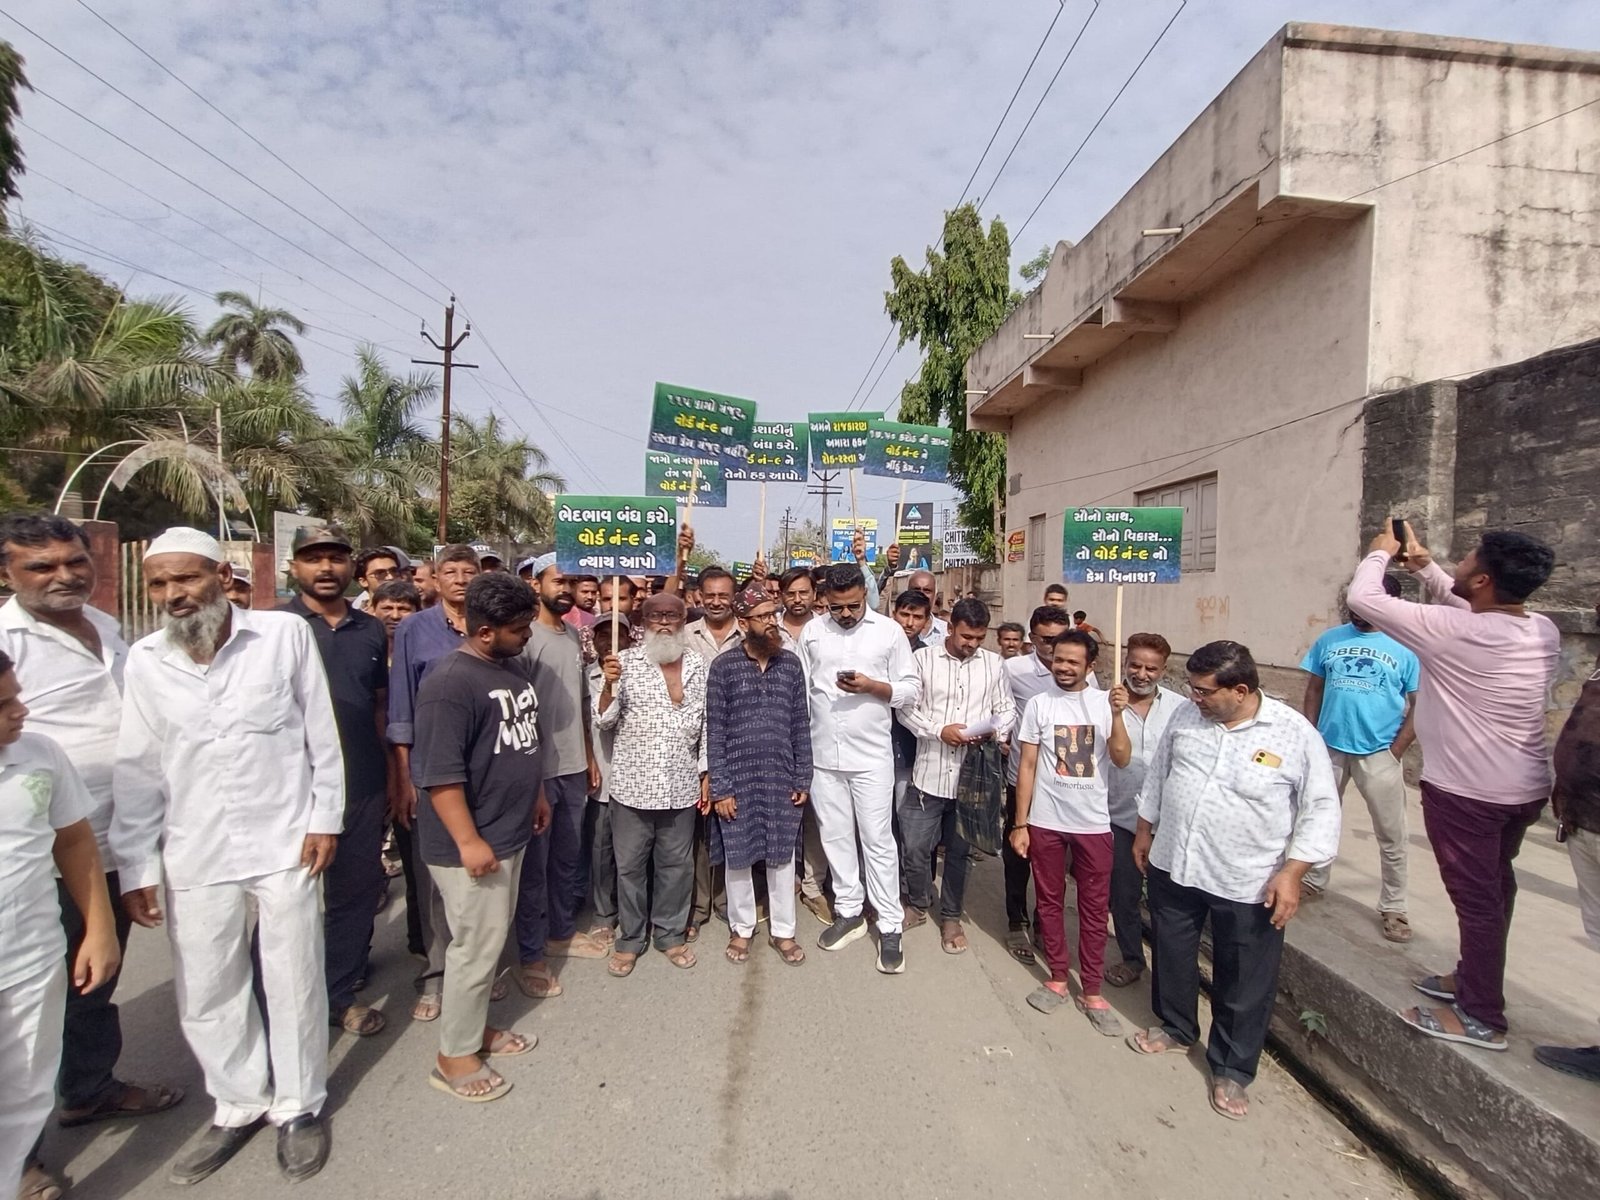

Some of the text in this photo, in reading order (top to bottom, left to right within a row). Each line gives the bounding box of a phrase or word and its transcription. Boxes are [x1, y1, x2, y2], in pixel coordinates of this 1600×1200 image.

[674, 412, 696, 429] વોર્ડ
[721, 426, 734, 436] ના
[810, 419, 867, 432] અમને રાજકારણ
[753, 439, 773, 449] બંધ
[825, 438, 850, 448] અમારા
[885, 444, 902, 456] વોર્ડ
[649, 453, 670, 464] જાગો
[757, 454, 781, 465] નં-૯
[785, 455, 794, 465] ને
[665, 467, 707, 480] તંત્ર જાો,
[724, 468, 746, 479] તેનો
[750, 471, 766, 480] હક
[660, 480, 677, 491] વોર્ડ
[558, 505, 675, 526] ભેદભાવ બંધ કરો,
[1073, 509, 1134, 524] સૌનો સાથ,
[578, 528, 656, 546] વોર્ડ નં-૯ ને
[1092, 528, 1173, 542] સૌનો વિકાસ...
[1076, 546, 1168, 561] તો વોર્ડ નં-૯ નો
[578, 552, 656, 569] ન્યાય આપો
[1086, 568, 1157, 583] કેમ વિનાશ?
[1327, 647, 1397, 670] OBERLIN
